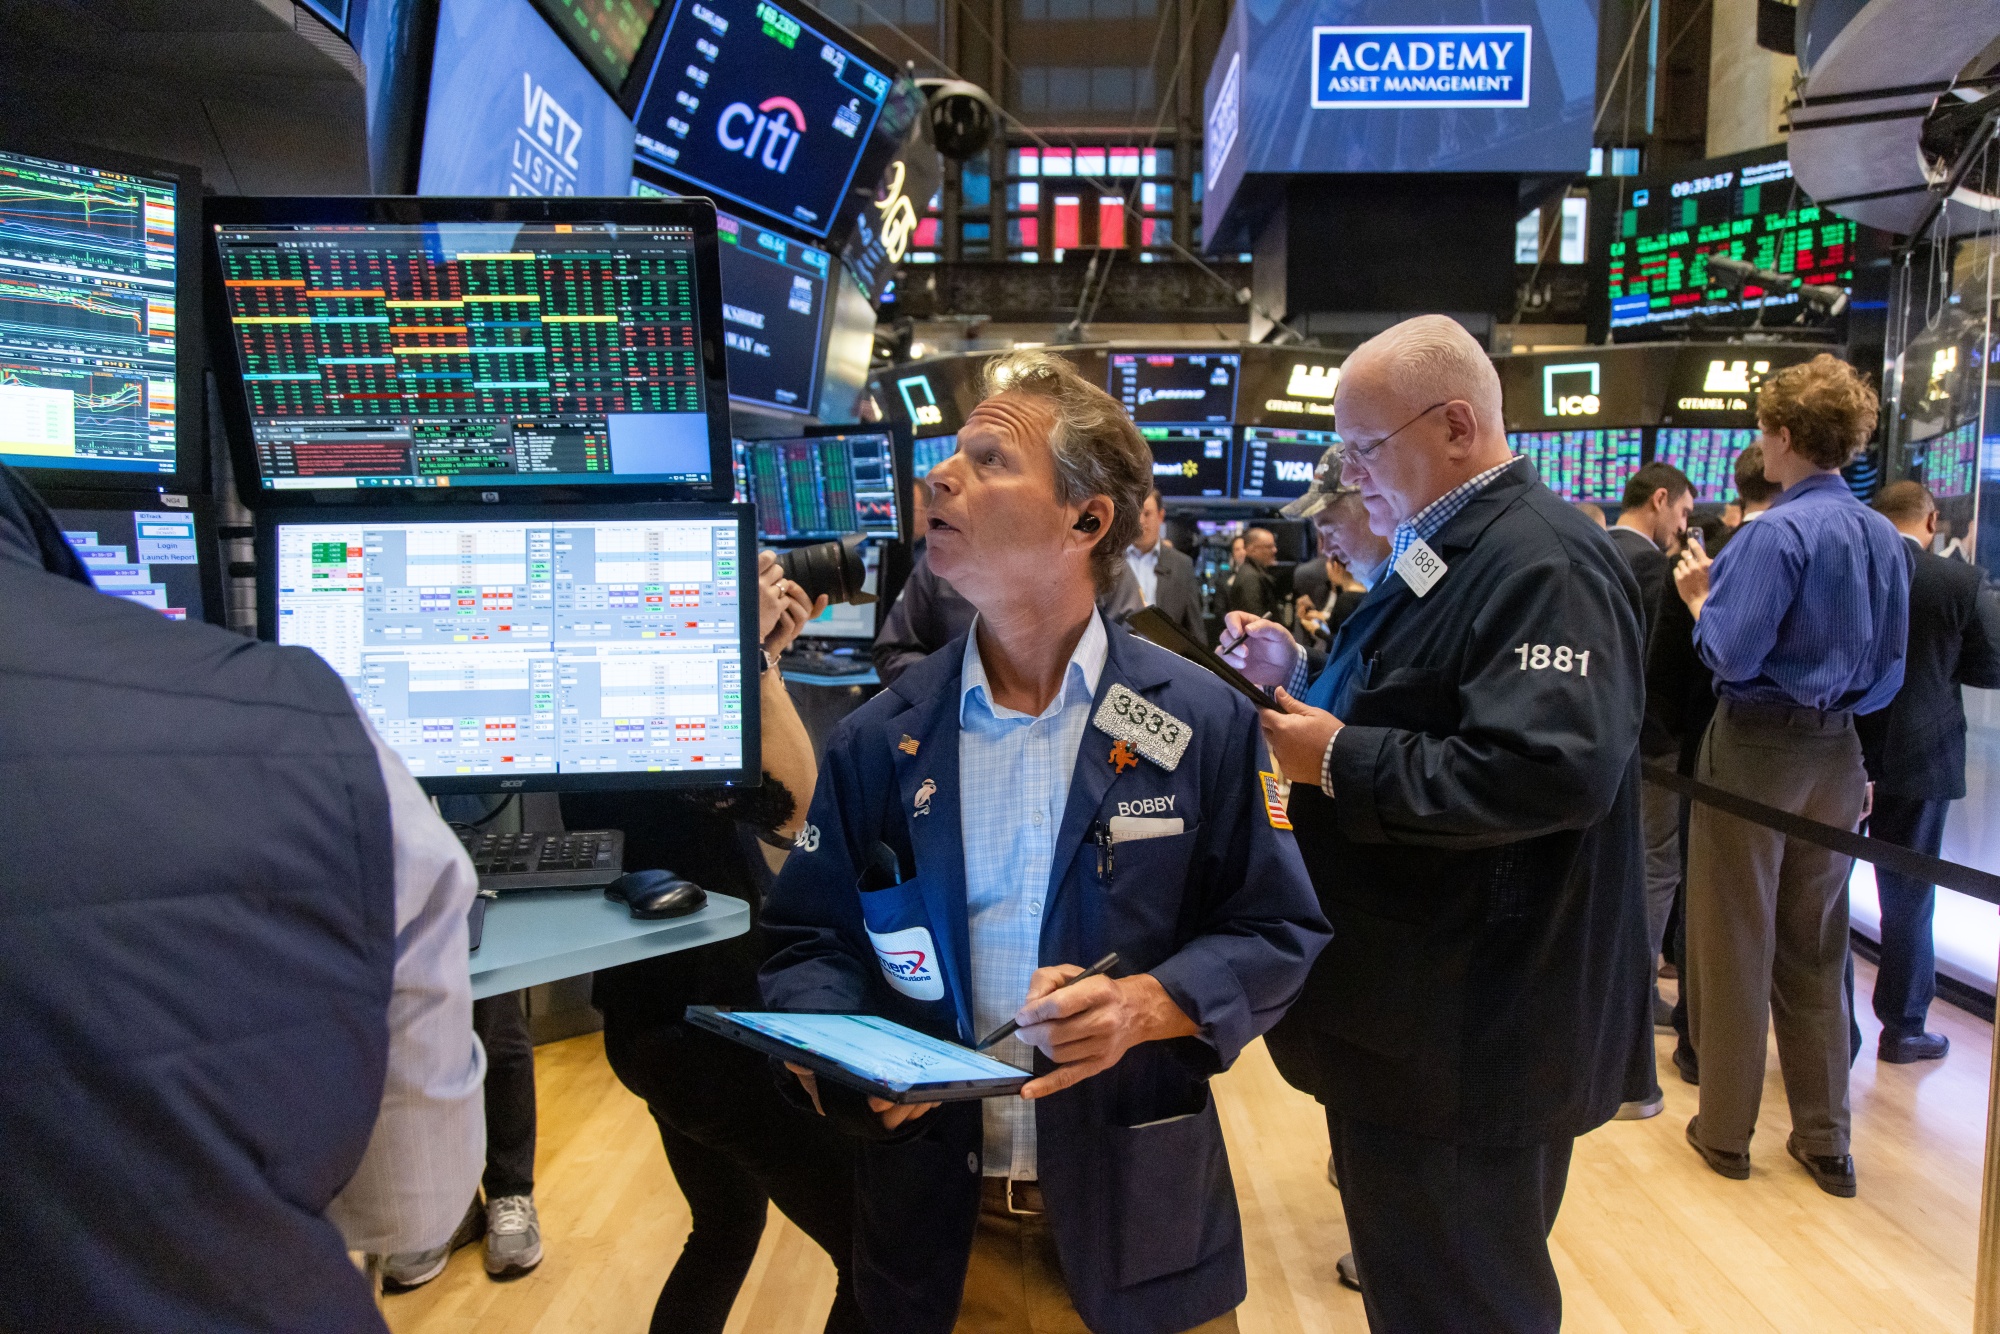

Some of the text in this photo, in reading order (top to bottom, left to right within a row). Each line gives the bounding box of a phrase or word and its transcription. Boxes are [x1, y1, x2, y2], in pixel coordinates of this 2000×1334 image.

[1328, 41, 1514, 71] ACADEMY
[1327, 75, 1513, 92] ASSET MANAGEMENT
[523, 71, 582, 170] VETZ
[716, 101, 802, 175] citi
[1671, 171, 1734, 199] 09:39:57
[1272, 460, 1314, 482] VISA
[141, 553, 195, 563] Launch Report
[157, 542, 178, 550] Login
[1412, 547, 1440, 580] 1881
[1514, 643, 1590, 677] 1881
[1113, 694, 1180, 744] 3333
[500, 779, 527, 788] acer
[1117, 794, 1176, 817] BOBBY
